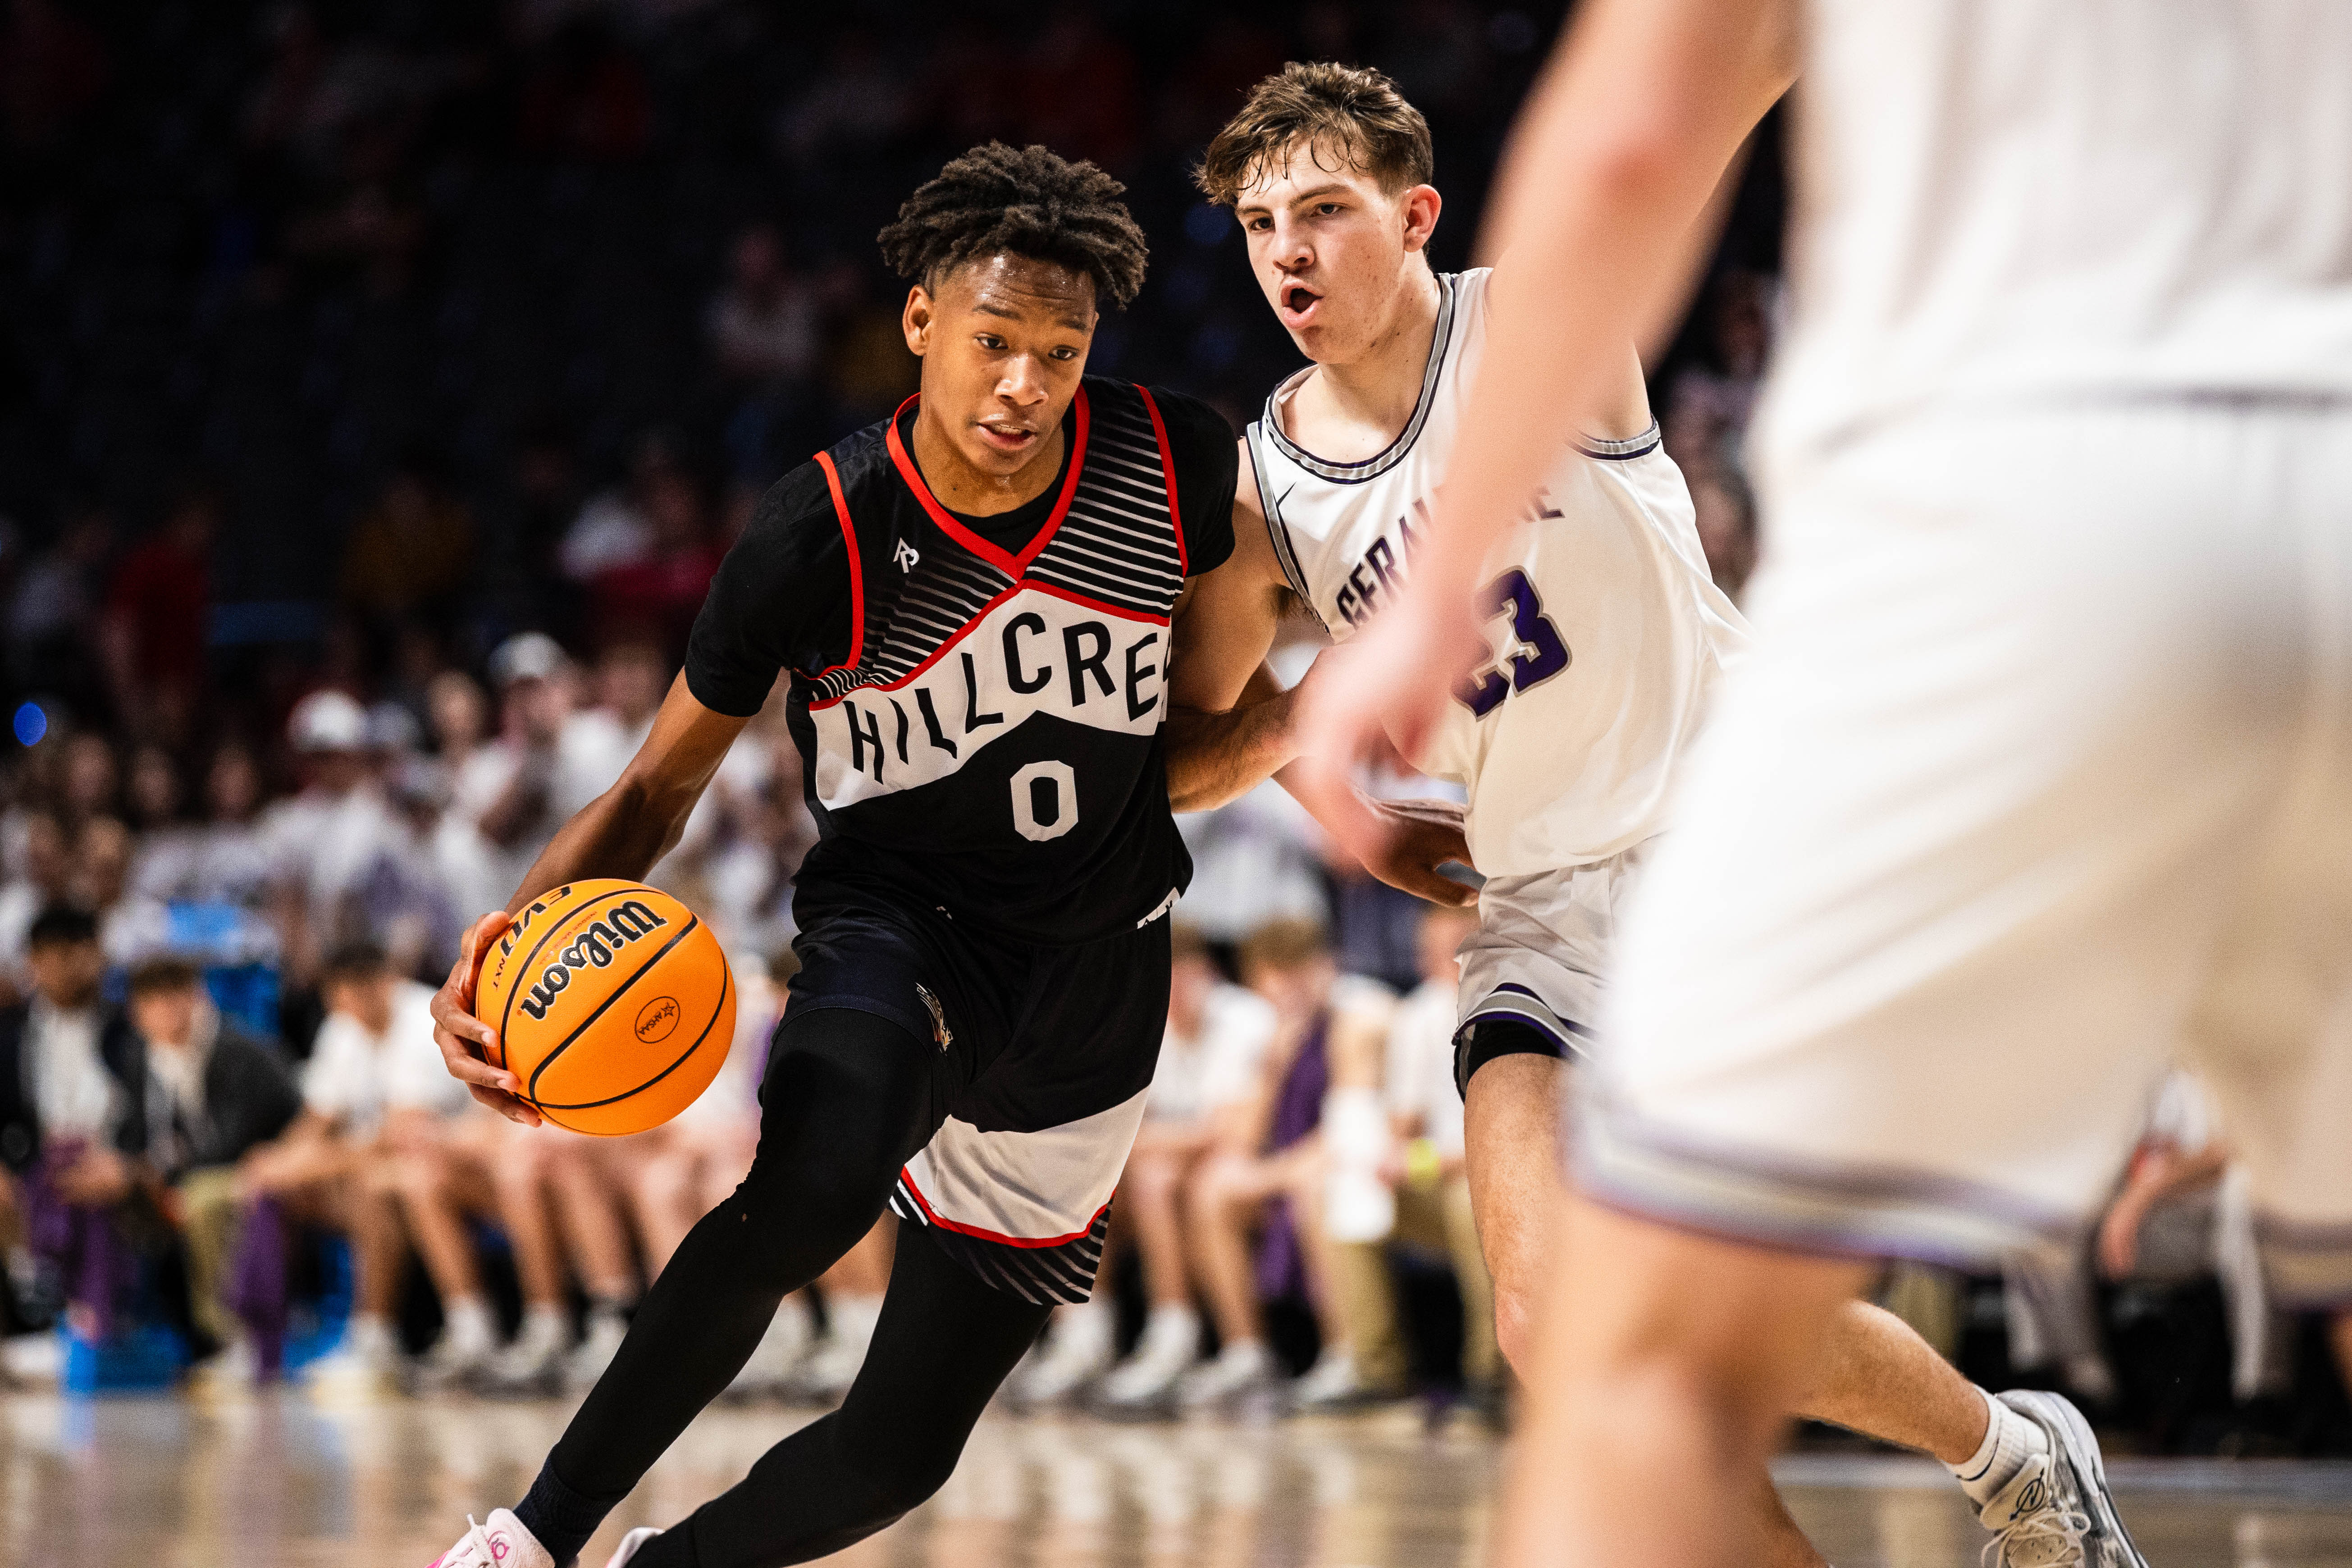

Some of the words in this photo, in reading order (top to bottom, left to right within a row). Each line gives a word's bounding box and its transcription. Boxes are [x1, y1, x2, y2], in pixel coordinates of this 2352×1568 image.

[1010, 760, 1078, 842] 0
[520, 900, 667, 1020] Wilson
[637, 1011, 662, 1035] AHSAA
